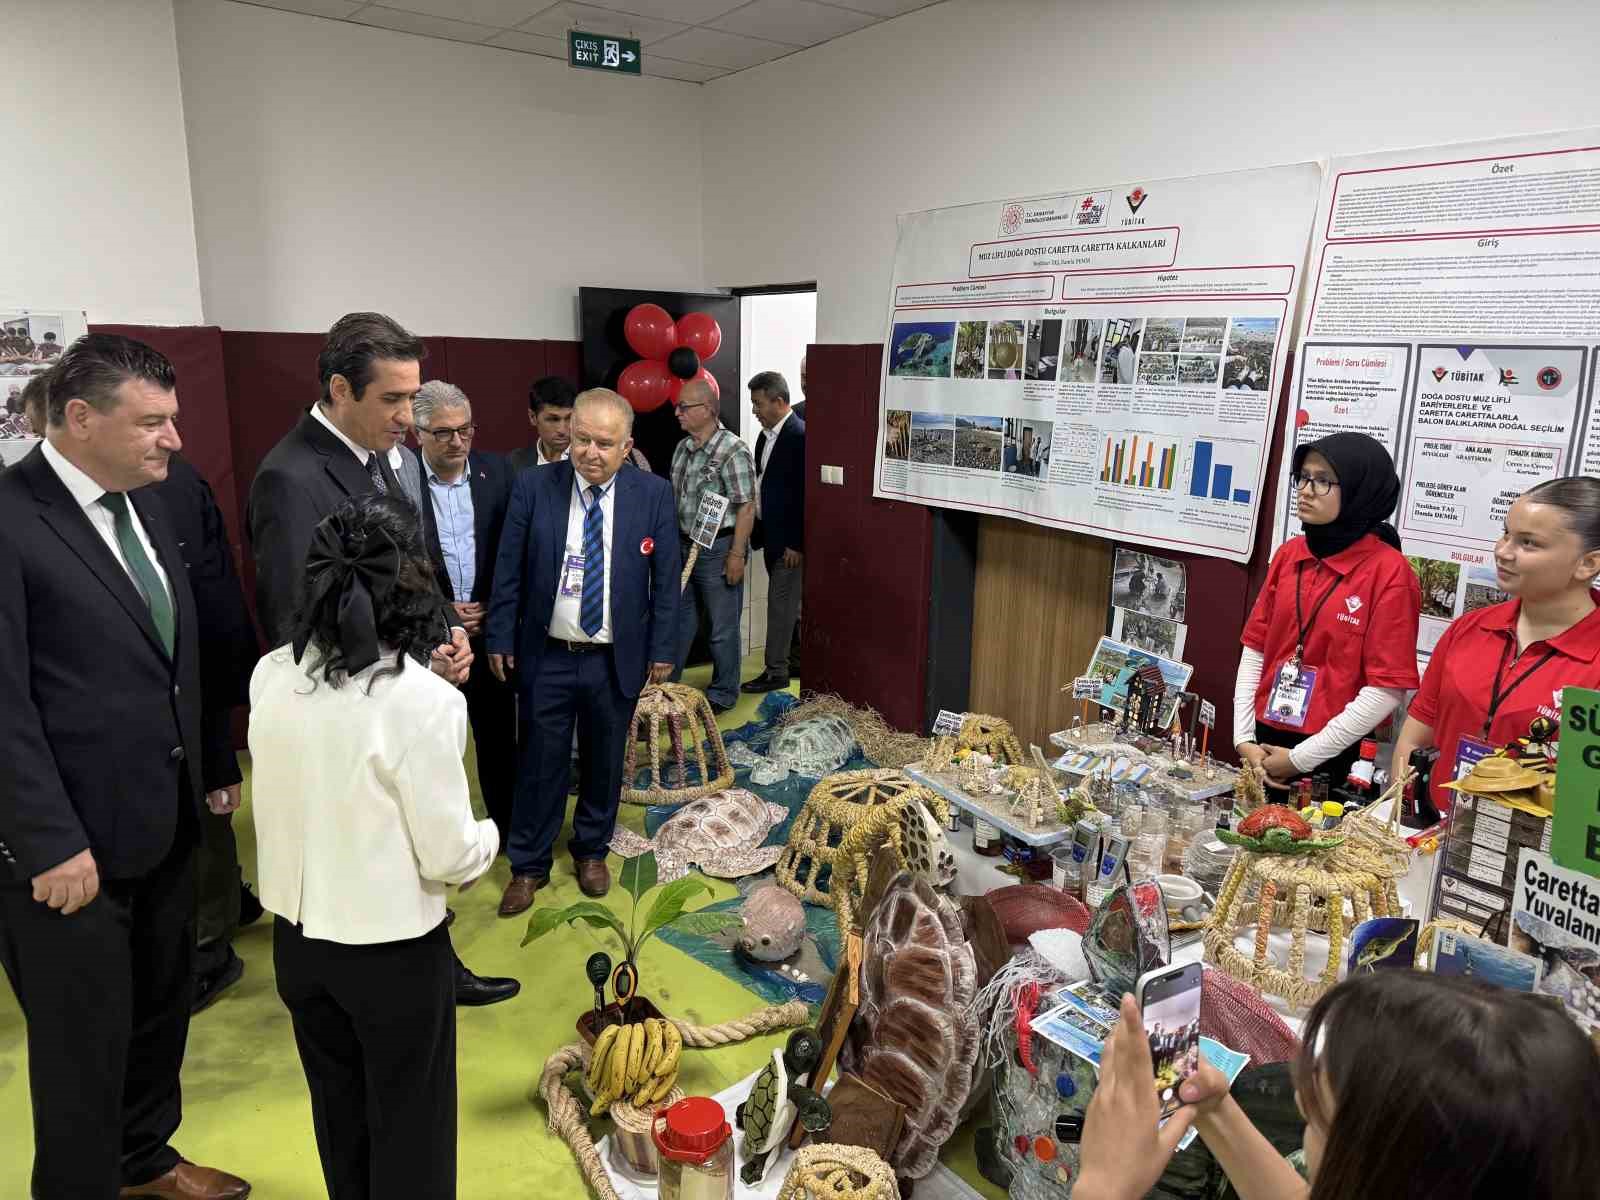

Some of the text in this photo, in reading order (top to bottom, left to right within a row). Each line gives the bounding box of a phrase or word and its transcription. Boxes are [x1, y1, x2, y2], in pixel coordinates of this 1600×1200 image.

[575, 39, 598, 52] ÇIKIŞ
[576, 51, 599, 62] EXIT
[1492, 163, 1514, 174] Özet
[1477, 237, 1500, 248] Giriş
[1007, 247, 1023, 258] DOĞA
[1024, 247, 1047, 256] DOSTU
[1047, 244, 1080, 255] CARETTA
[1081, 242, 1115, 252] CARETTA
[1116, 239, 1167, 250] KALKANLARI
[1316, 358, 1340, 367] Problem
[1345, 358, 1360, 368] Soru
[1361, 358, 1387, 368] Cümlesi
[1450, 370, 1484, 382] TÜBİTAK
[1421, 393, 1443, 401] DOĞA
[1444, 394, 1471, 402] DOSTU
[1491, 395, 1511, 404] LİFLİ
[1420, 400, 1477, 411] BARİYERLERLE
[1419, 409, 1519, 421] CARETTA CARETTALARLA
[1418, 417, 1565, 434] BALON BALIKLARINA DOĞAL SEÇİLİM
[1453, 485, 1467, 493] ALAN
[1491, 496, 1513, 506] ÖĞRETM
[1434, 512, 1458, 521] DEMİR
[1451, 551, 1485, 564] BULGULAR
[1336, 612, 1360, 625] TÜBİTAK
[1524, 859, 1600, 916] Caretta
